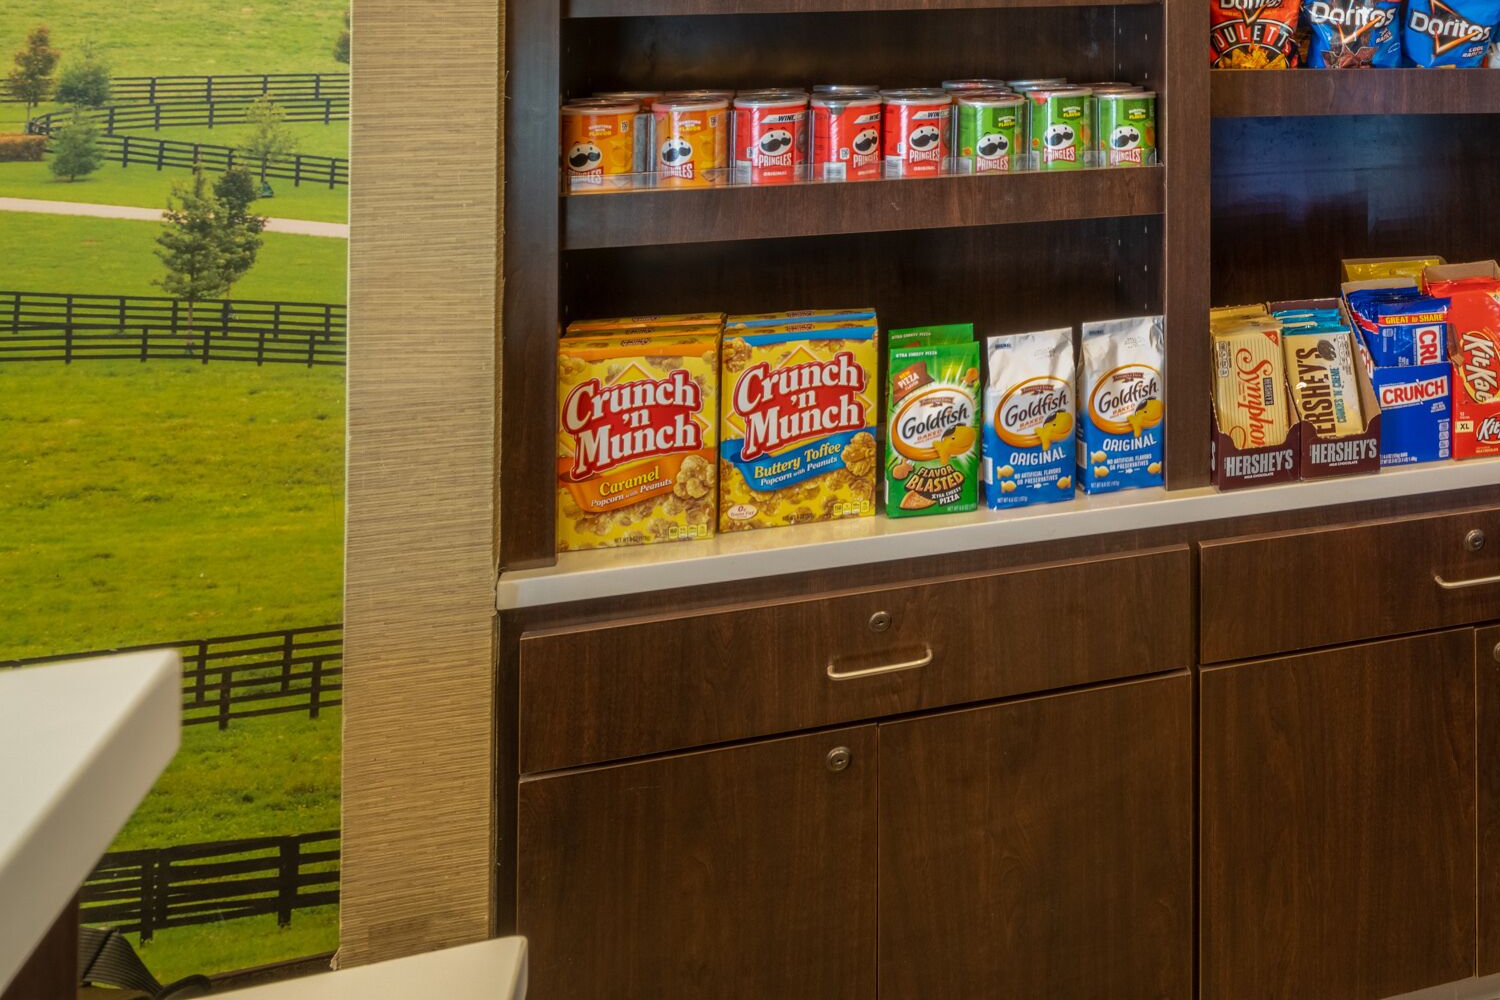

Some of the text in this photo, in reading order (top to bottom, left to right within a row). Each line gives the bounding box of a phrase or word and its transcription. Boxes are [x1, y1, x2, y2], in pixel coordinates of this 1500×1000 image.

[1311, 2, 1396, 28] Doritos
[1410, 11, 1490, 42] Doritos
[758, 153, 792, 168] PRINGLES
[909, 149, 940, 163] PRINGLES
[976, 159, 1009, 171] PRINGLES
[1043, 148, 1076, 162] PRINGLES
[1110, 149, 1141, 163] PRINGLES
[1385, 315, 1410, 324] GREAT
[1419, 314, 1444, 322] SHARE
[736, 355, 859, 410] Crunch
[898, 372, 920, 388] PIZZA
[566, 373, 696, 432] Crunch
[1098, 377, 1158, 413] Goldfish
[1382, 379, 1445, 405] CRUNCH
[1005, 390, 1068, 427] Goldfish
[1112, 403, 1135, 416] BAKED
[748, 398, 860, 453] Munch
[902, 404, 970, 440] Goldfish
[1019, 416, 1044, 428] BAKED
[1460, 422, 1470, 430] XL
[575, 417, 695, 474] Munch
[917, 428, 943, 440] BAKED
[1102, 434, 1157, 452] ORIGINAL
[754, 442, 842, 480] Buttery Toffee
[1010, 447, 1066, 466] ORIGINAL
[1310, 438, 1377, 463] HERSHEY'S
[760, 472, 792, 486] Popcorn
[806, 456, 838, 472] Peanuts
[918, 464, 954, 478] FLAVOR
[1225, 449, 1293, 478] HERSHEY'S
[591, 492, 624, 508] Popcorn
[640, 478, 673, 493] Peanuts
[599, 467, 660, 497] Caramel
[906, 471, 964, 492] BLASTED
[940, 494, 960, 505] PIZZA
